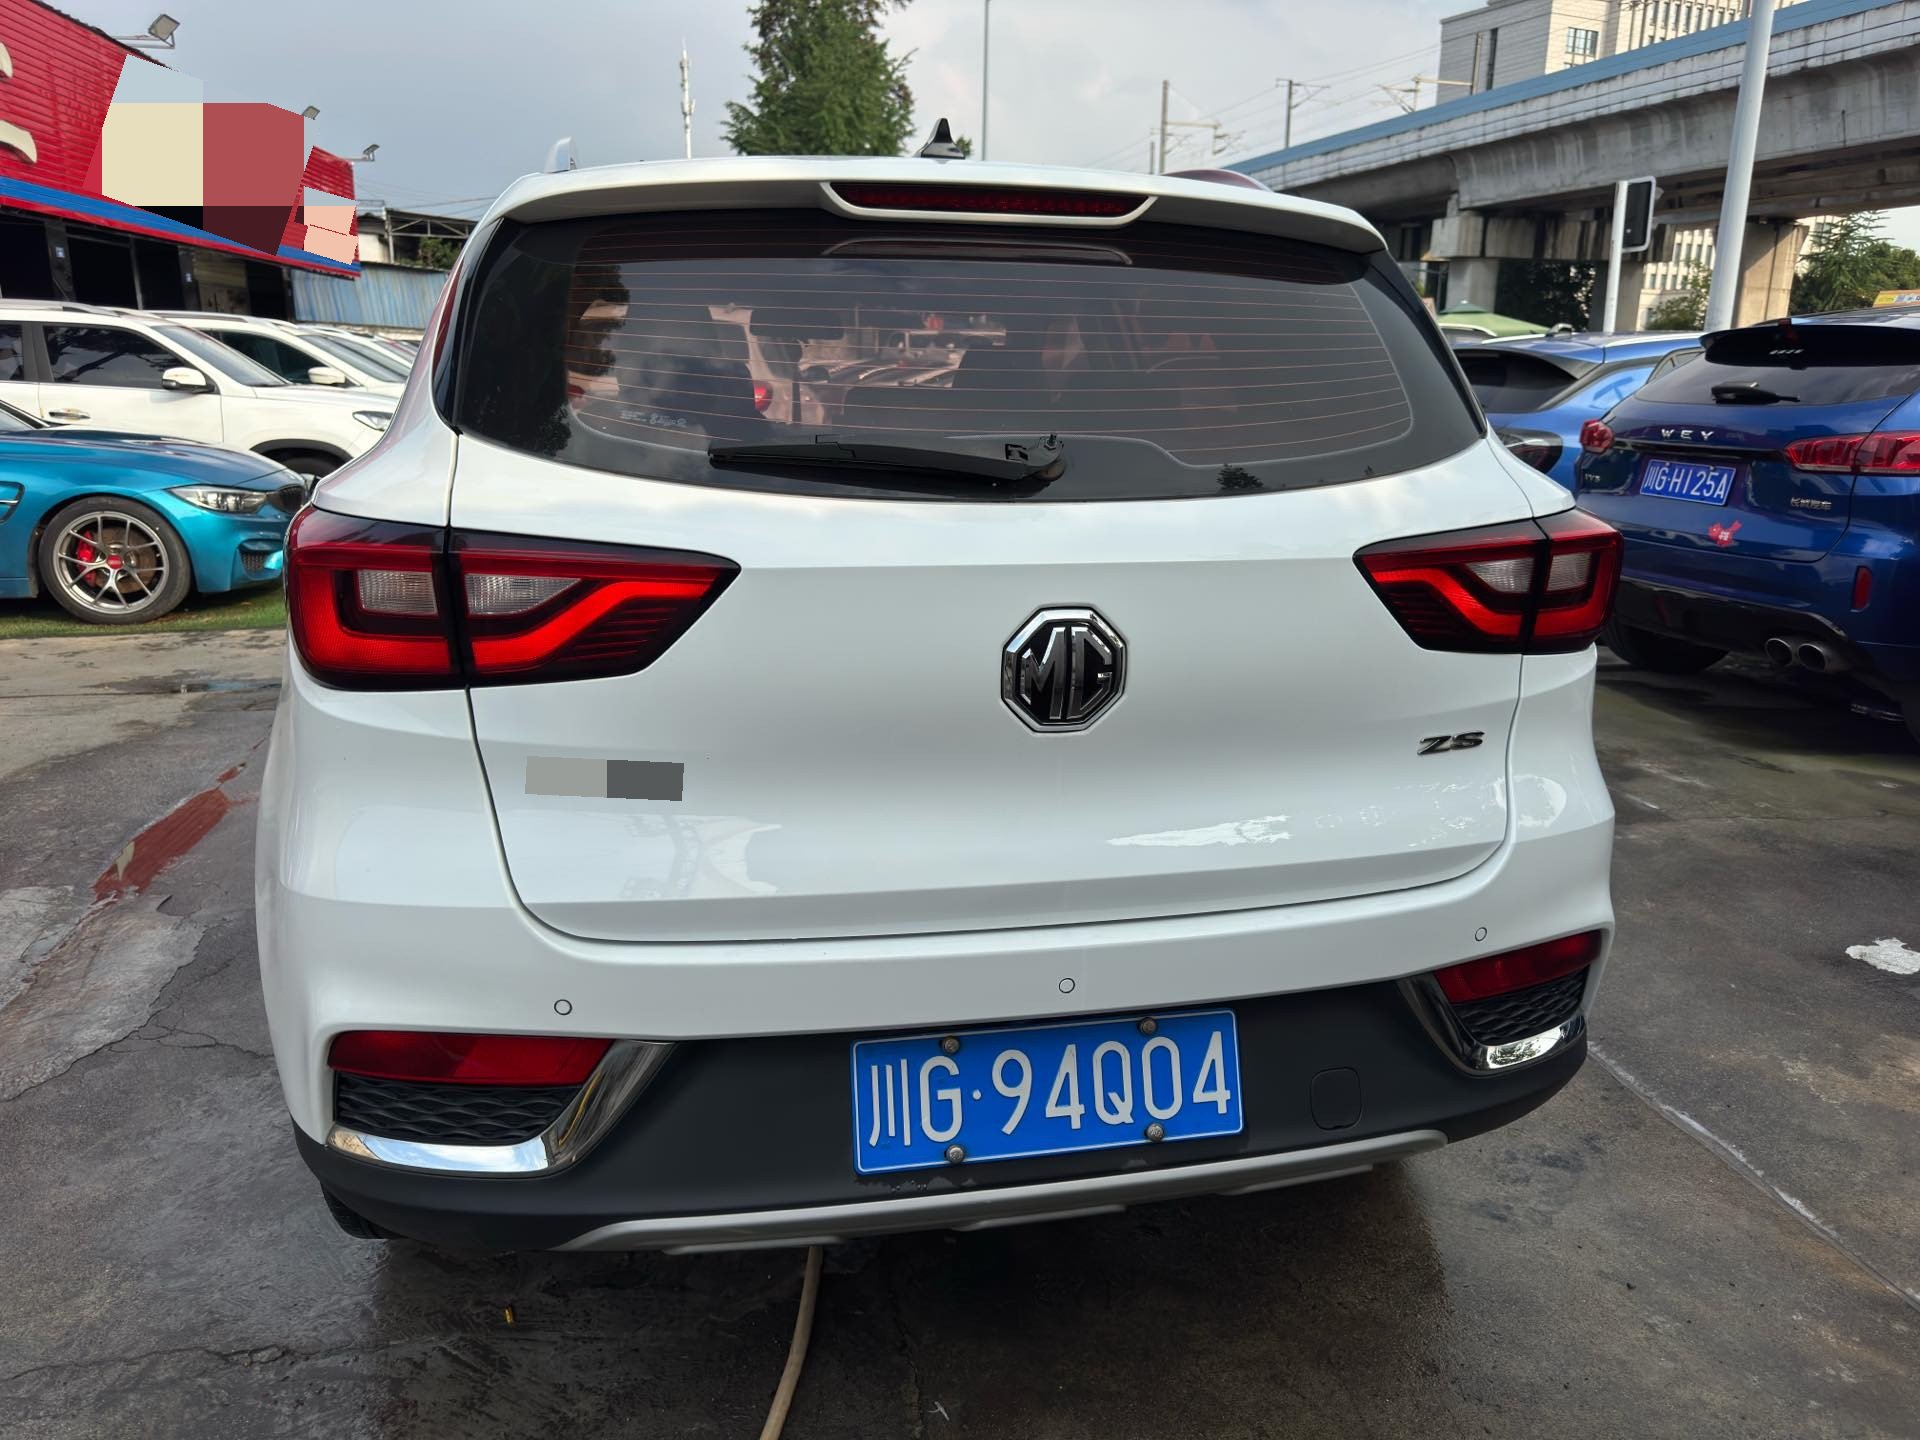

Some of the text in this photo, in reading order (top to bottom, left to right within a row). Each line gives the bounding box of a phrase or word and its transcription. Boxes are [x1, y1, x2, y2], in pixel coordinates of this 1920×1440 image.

[1661, 428, 1715, 440] WEY
[1018, 624, 1114, 721] MG
[1417, 731, 1485, 756] ZS
